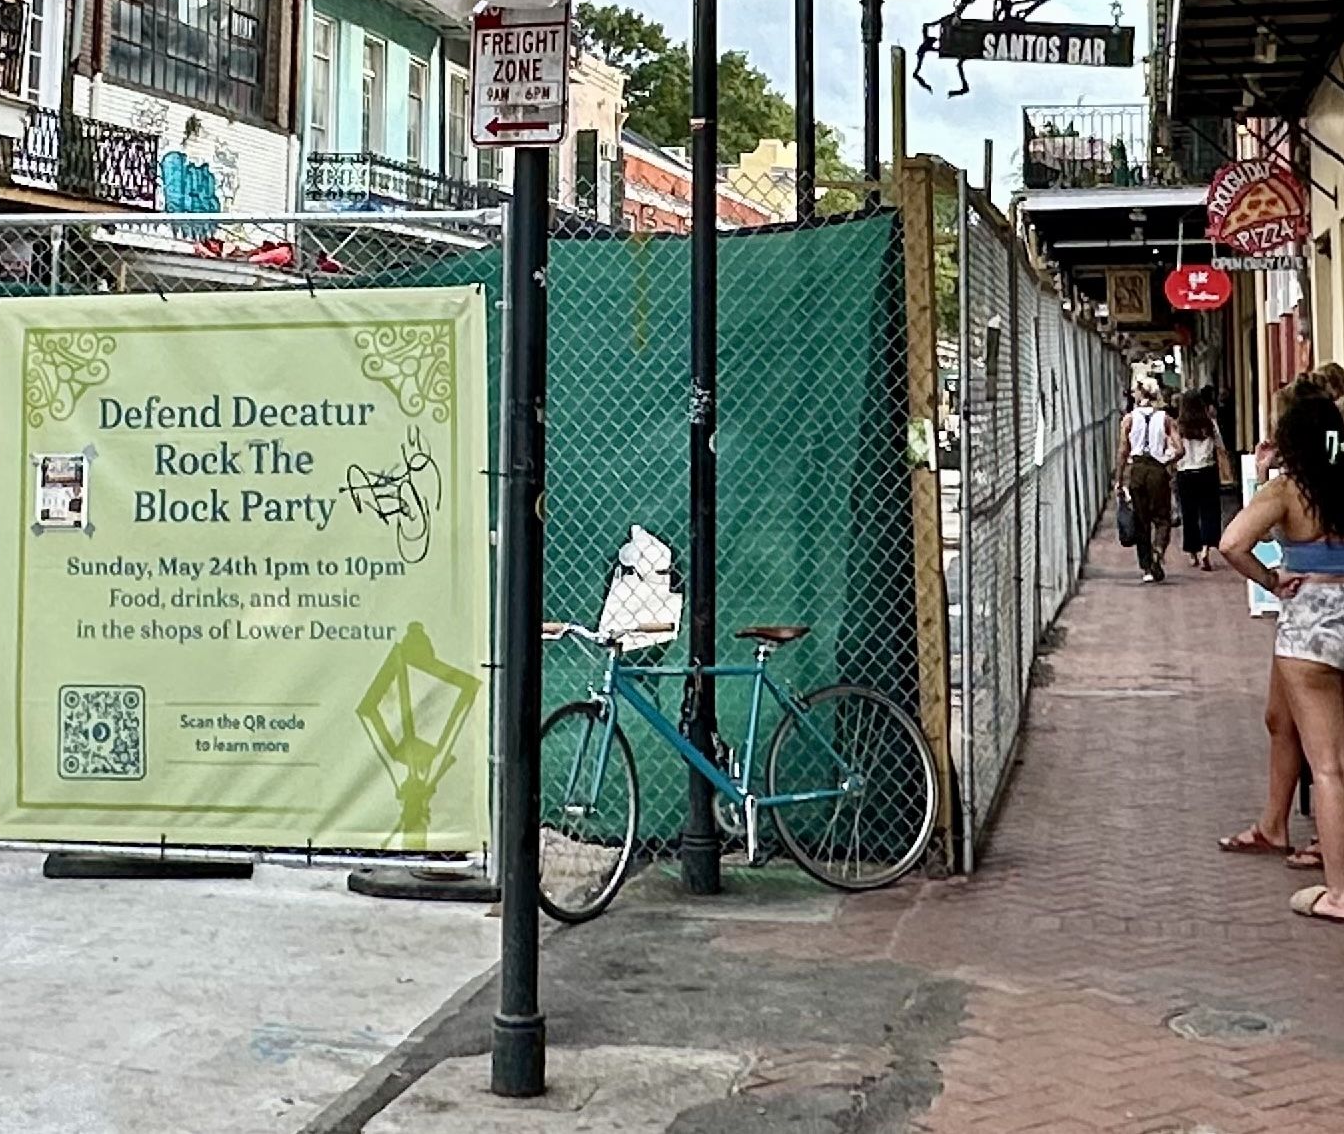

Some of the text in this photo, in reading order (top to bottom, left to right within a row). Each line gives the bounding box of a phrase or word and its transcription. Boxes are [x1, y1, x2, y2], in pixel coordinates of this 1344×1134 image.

[481, 30, 560, 56] FREIGHT
[983, 32, 1106, 65] SANTOS BAR
[493, 58, 543, 84] ZONE
[486, 87, 510, 102] 9AM
[524, 86, 551, 100] 6PM
[1236, 219, 1296, 252] PIZZA
[99, 394, 376, 429] Defend Decatur
[154, 440, 314, 477] Rock The
[134, 489, 338, 531] Block Party
[66, 555, 406, 581] Sunday, May 24th 1pm to 10pm
[109, 586, 361, 610] Food, drinks, and music
[76, 618, 397, 645] in the shops of Lower Decatur
[180, 714, 306, 733] Scan the QR code
[195, 736, 290, 753] to learn more
